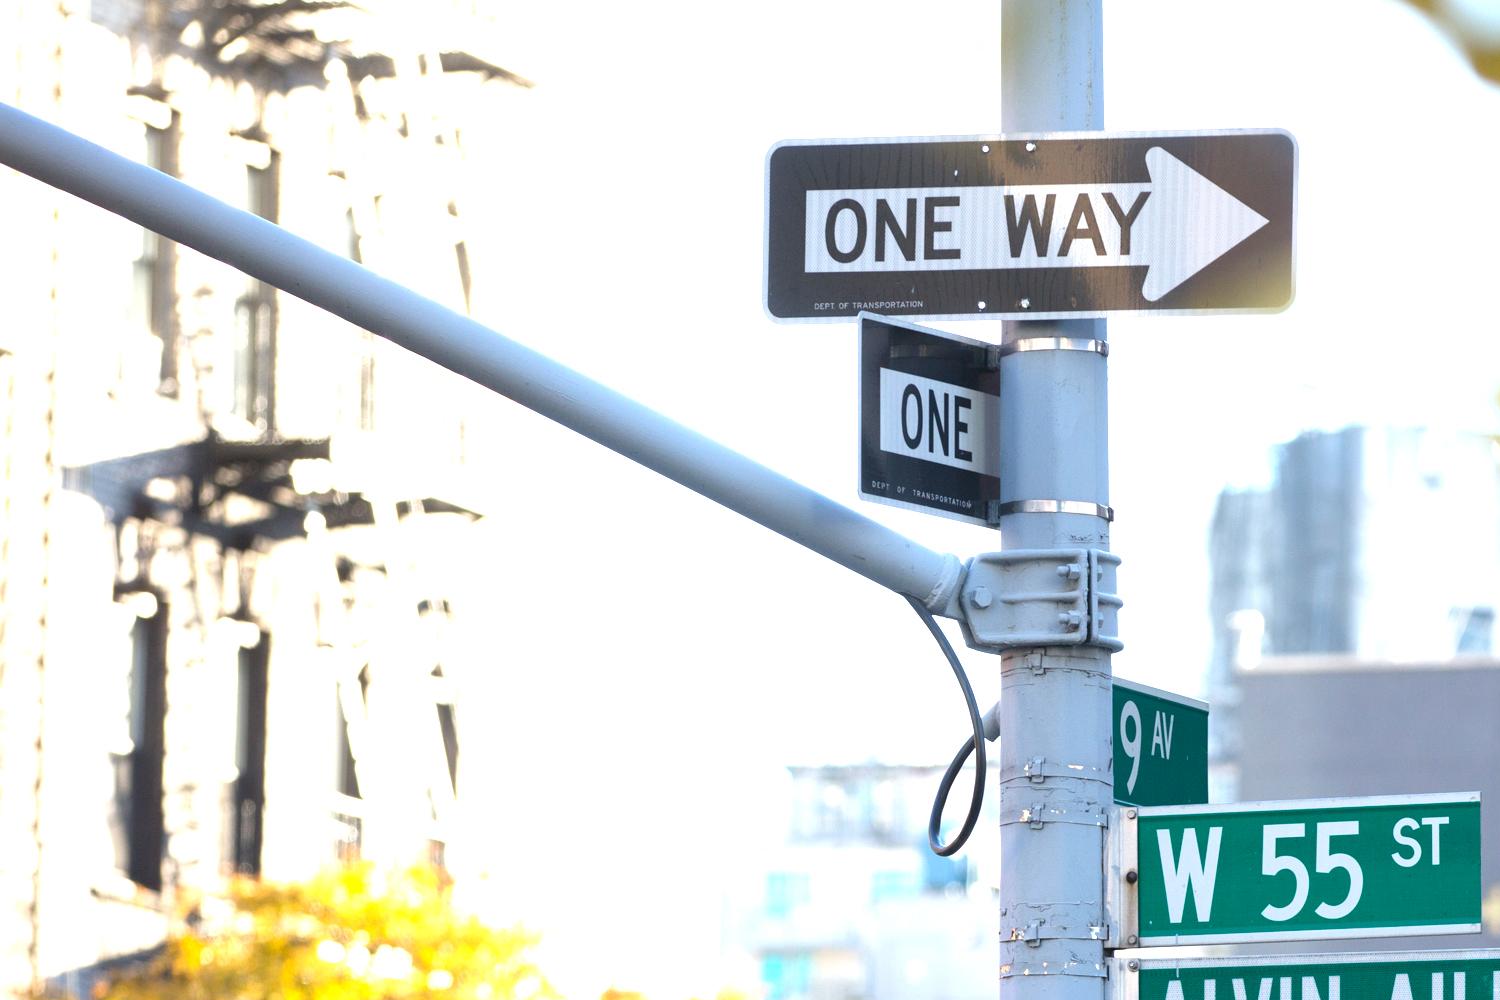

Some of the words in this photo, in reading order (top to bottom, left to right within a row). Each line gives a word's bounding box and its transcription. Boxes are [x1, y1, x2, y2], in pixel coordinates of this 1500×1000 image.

[825, 196, 962, 264] ONE
[1004, 191, 1150, 258] WAY
[814, 302, 836, 310] DEPT
[853, 300, 924, 309] TRANSPORTATION
[902, 384, 973, 462] ONE
[871, 480, 891, 491] DEPT
[896, 486, 906, 494] OF
[1120, 701, 1142, 796] 9
[1152, 711, 1175, 760] AV
[1157, 827, 1223, 924] W
[1261, 821, 1364, 921] 55
[1392, 817, 1450, 868] ST
